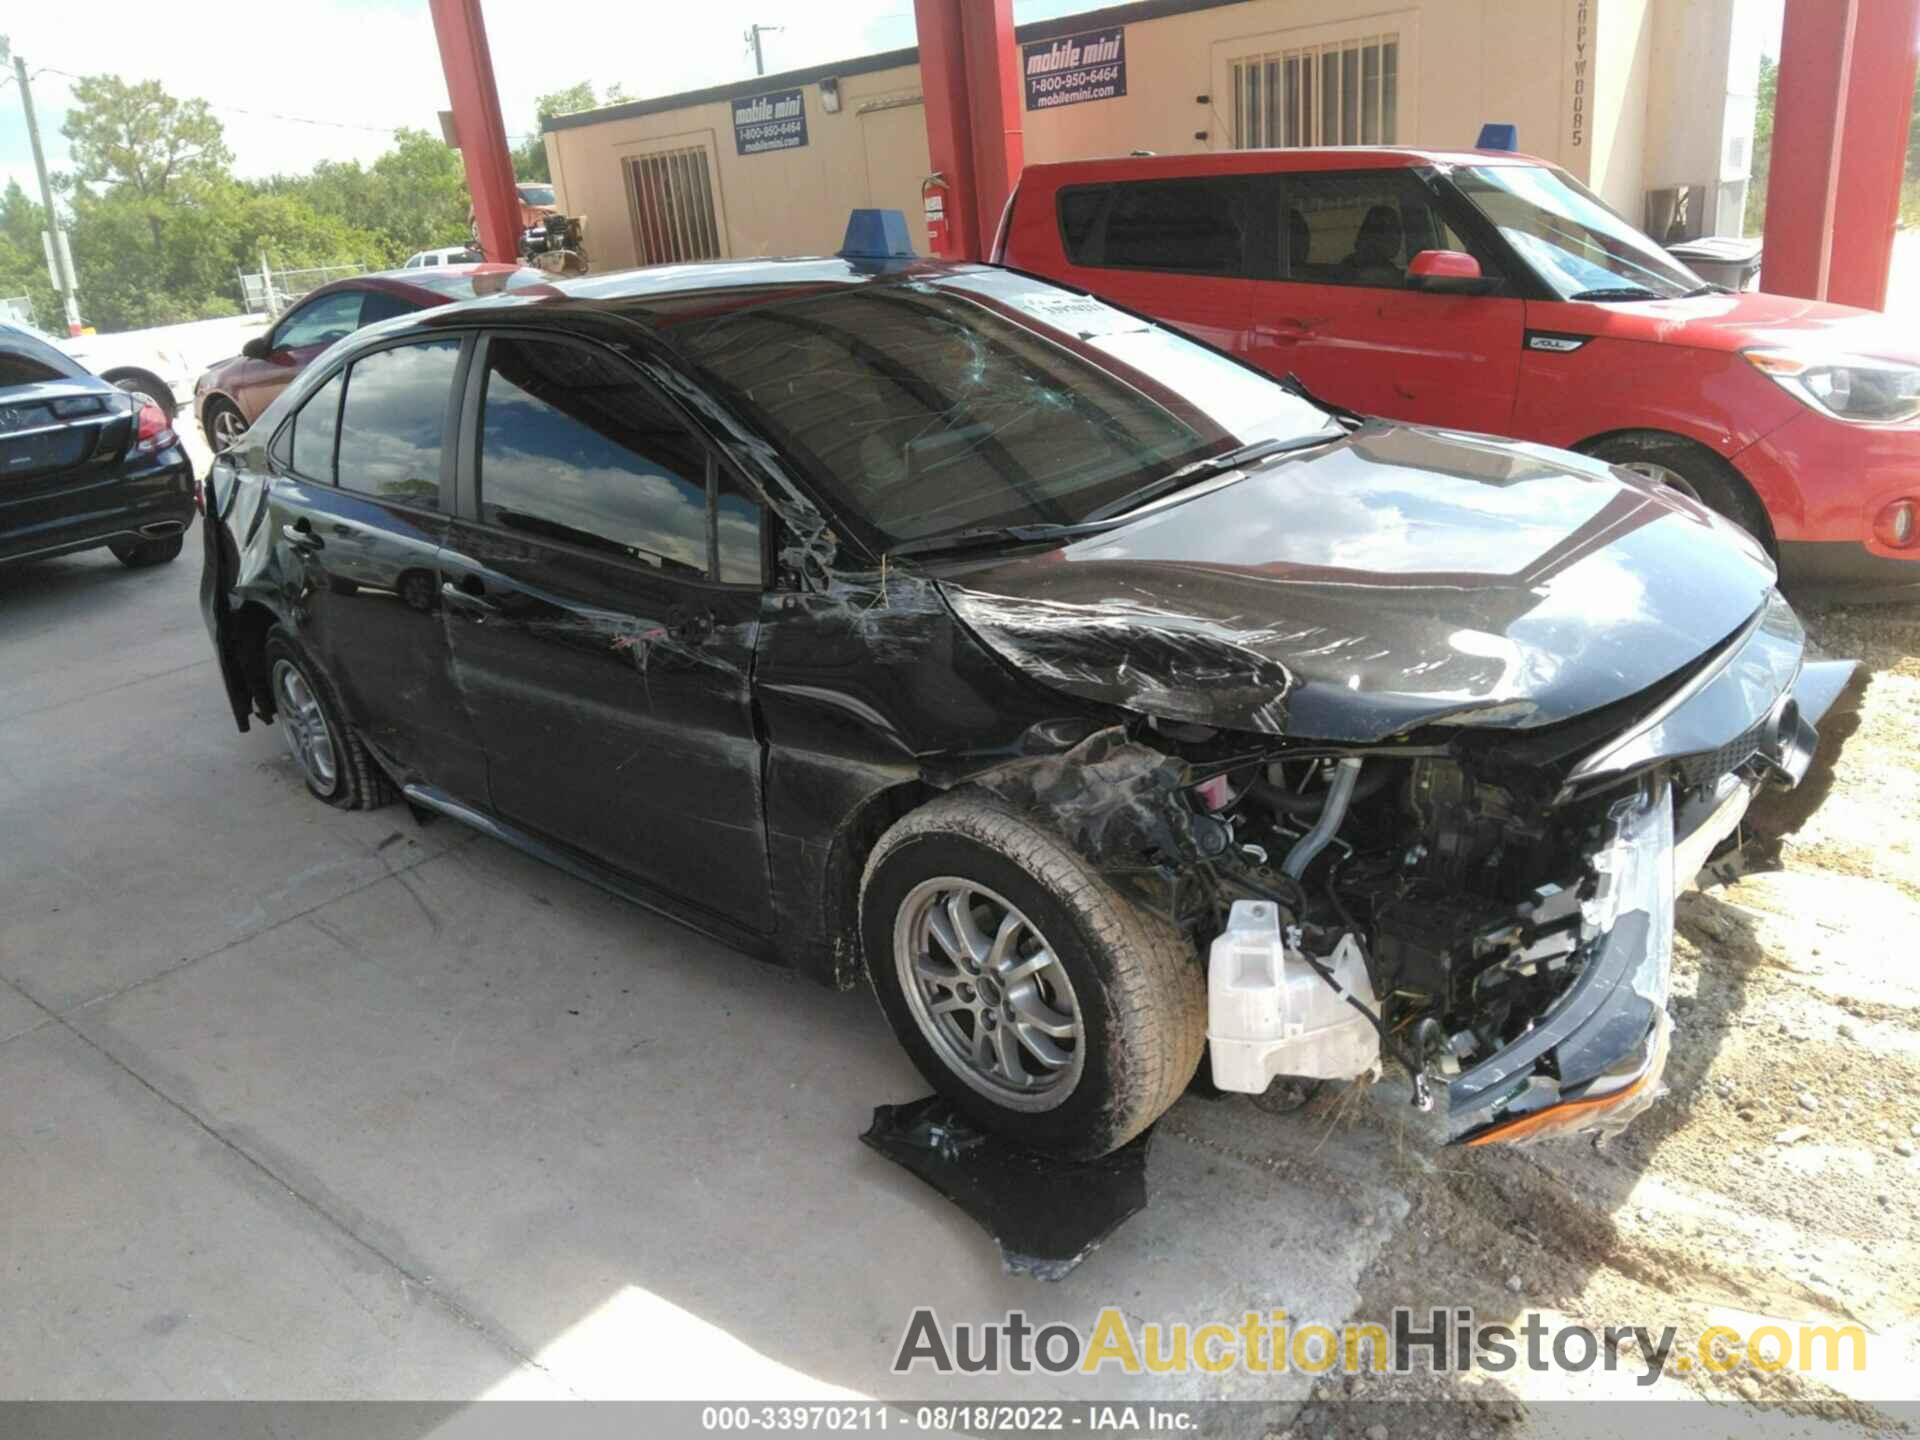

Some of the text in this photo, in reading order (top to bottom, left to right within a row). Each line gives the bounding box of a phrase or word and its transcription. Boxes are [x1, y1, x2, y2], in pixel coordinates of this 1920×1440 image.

[1027, 34, 1121, 74] mobile mini
[1031, 66, 1118, 93] 1-800-950-6464
[736, 95, 801, 124] mobile mini
[1037, 85, 1114, 107] mobilemini.com
